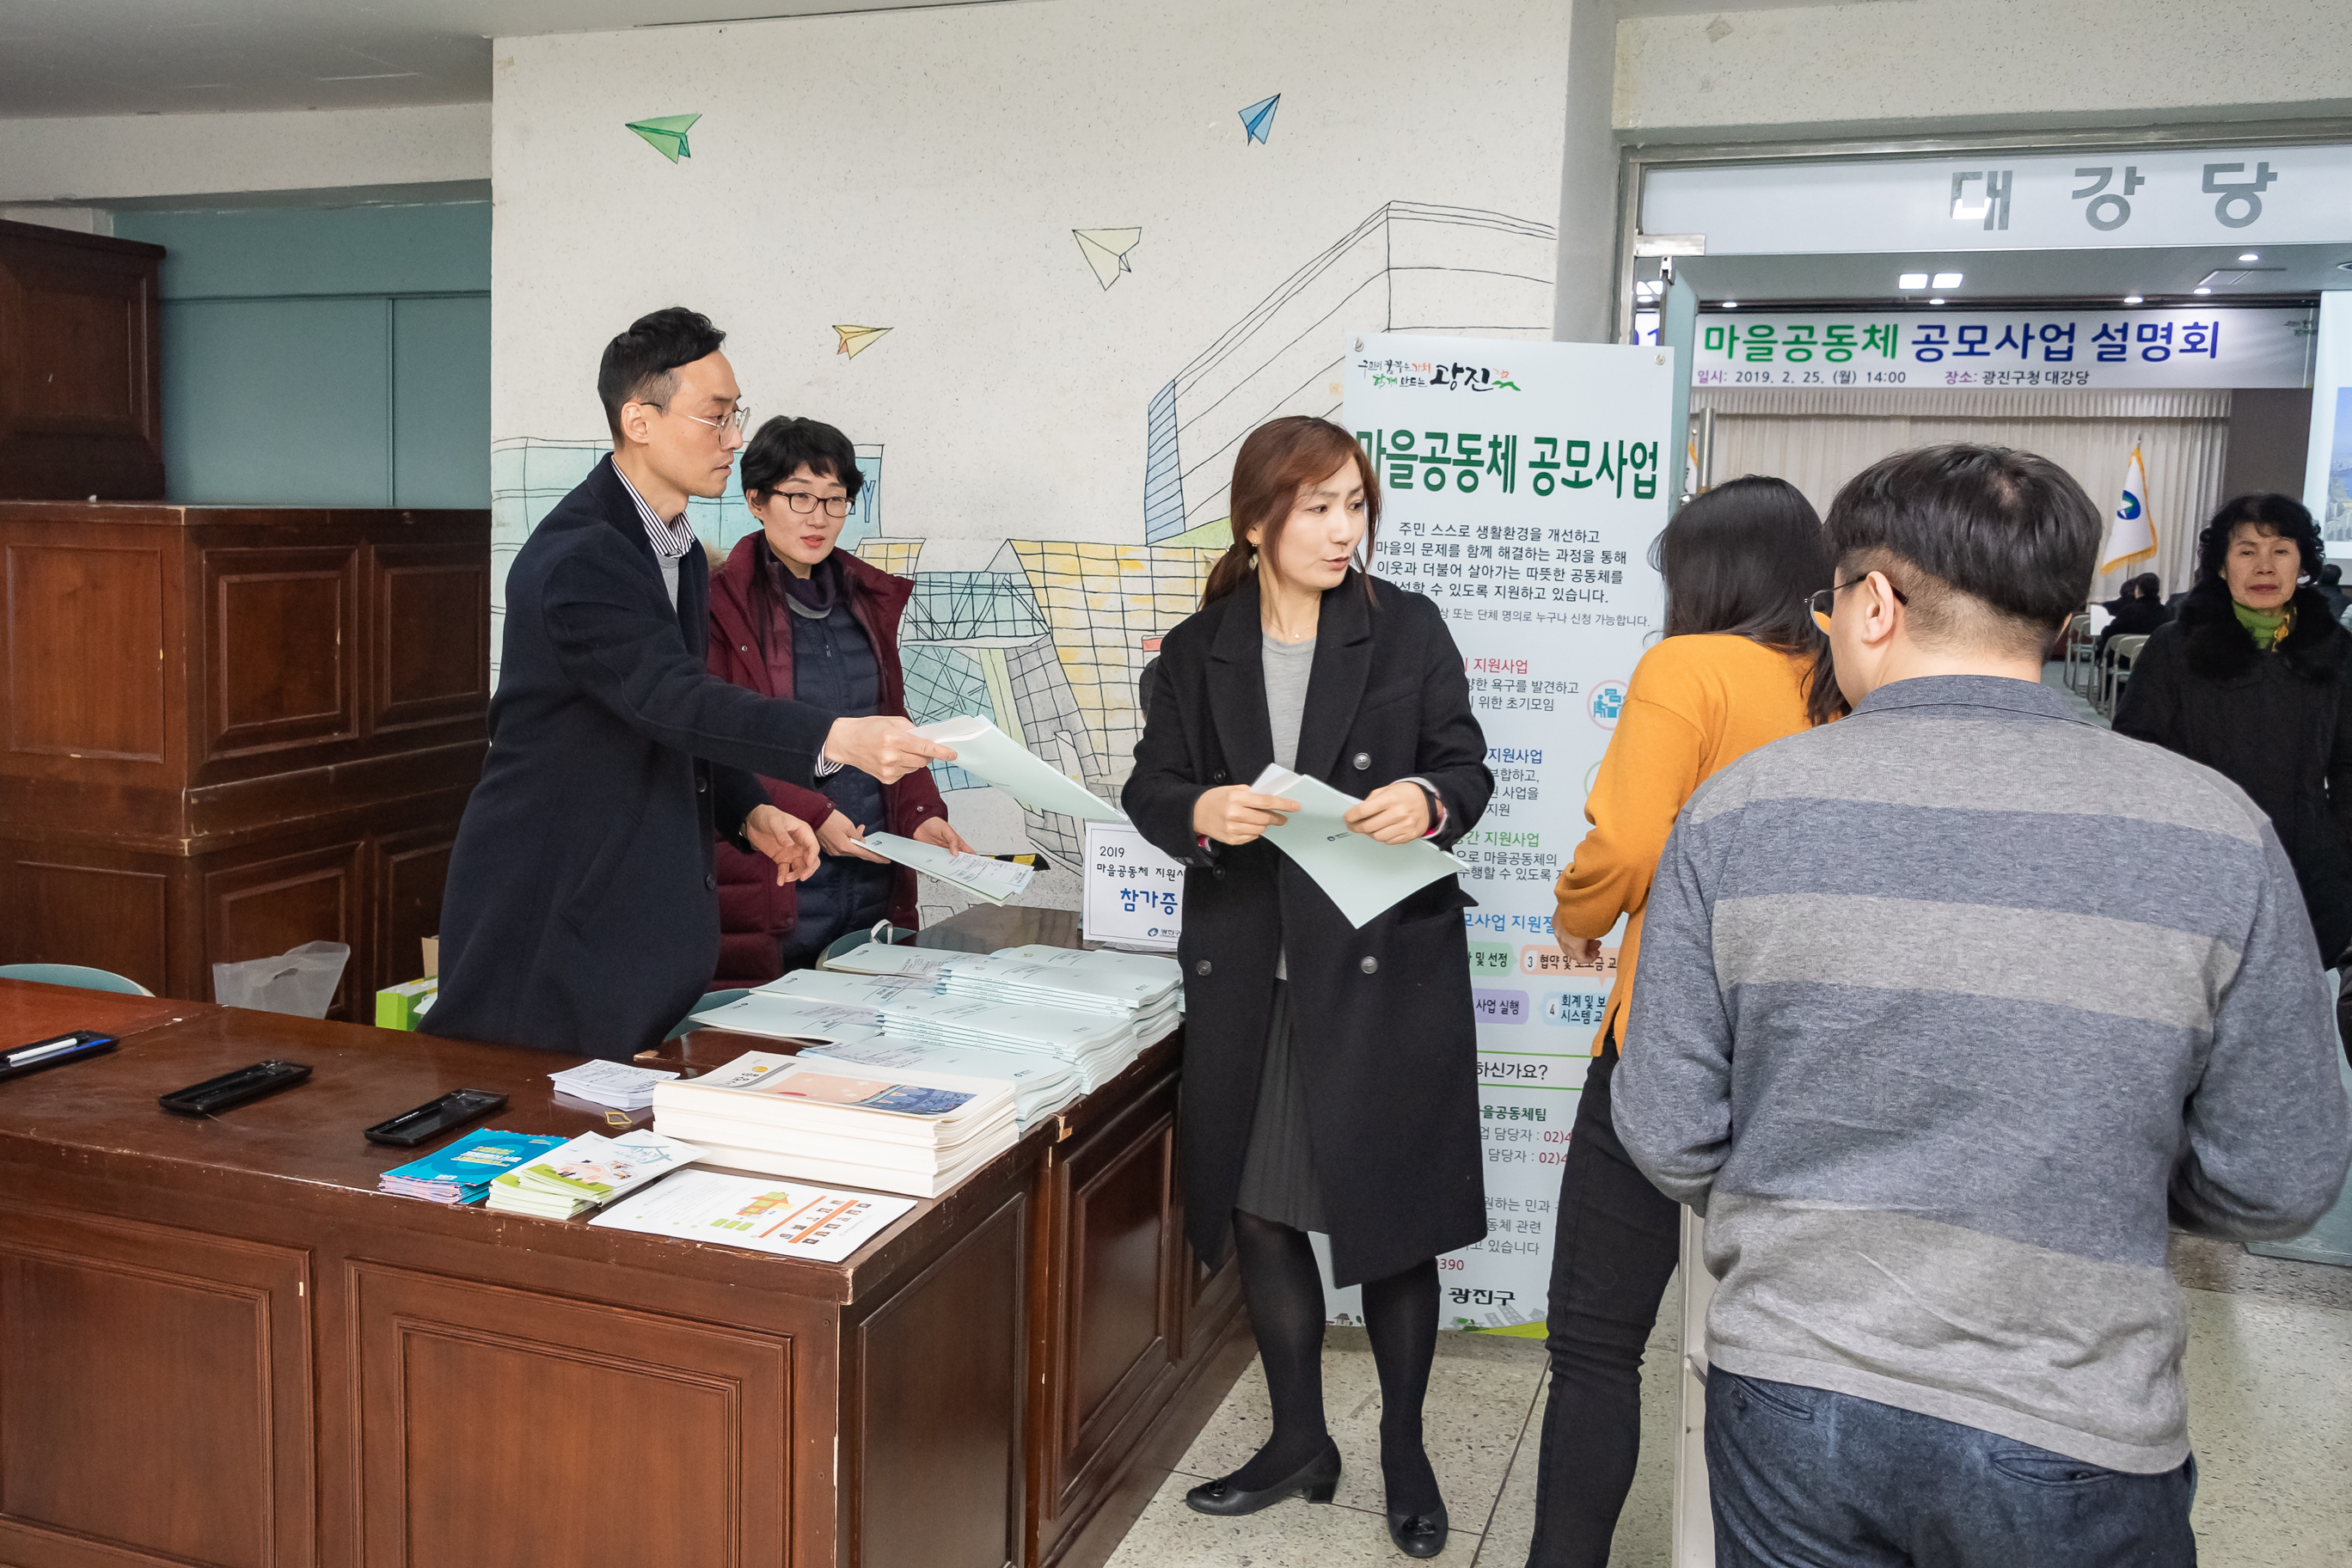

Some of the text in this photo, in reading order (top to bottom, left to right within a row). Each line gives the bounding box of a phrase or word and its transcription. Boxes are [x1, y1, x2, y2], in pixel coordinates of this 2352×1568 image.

[1704, 323, 1899, 363] 마을공동체
[1911, 322, 2076, 363] 공모사업
[2091, 321, 2220, 363] 설명회
[1429, 361, 1494, 392] 광진
[1697, 370, 1907, 386] 일시: 2019. 2. 25. (월) 14:00
[1944, 370, 2091, 385] 장소: 광진구청 대강당
[1528, 436, 1659, 500] 공모사업
[1399, 521, 1601, 543] 주민 스스로 생활환경을 개선하고
[1375, 541, 1627, 565] 마을의 문제를 함께 해결하는 과정을 통해
[1377, 560, 1624, 585] 이웃과 더불어 살아가는 따뜻한 공동체를
[1430, 582, 1443, 597] 수
[1449, 583, 1488, 598] 있도록
[1493, 585, 1547, 601] 지원하고
[1552, 586, 1609, 603] 있습니다.
[1452, 608, 1474, 622] 또는
[1477, 609, 1498, 622] 단체
[1502, 609, 1533, 622] 명의로
[1535, 611, 1567, 624] 누구나
[1570, 613, 1592, 626] 신청
[1595, 613, 1651, 628] 가능합니다.
[1473, 658, 1528, 675] 지원사업
[1491, 678, 1528, 693] 욕구를
[1531, 680, 1580, 695] 발견하고
[1478, 695, 1504, 710] 위한
[1505, 696, 1554, 712] 초기모임
[1487, 747, 1543, 764] 지원사업
[1502, 786, 1540, 800] 사업을
[1485, 803, 1510, 818] 지원
[1484, 831, 1540, 848] 지원사업
[1099, 846, 1125, 858] 2019
[1484, 851, 1558, 867] 마을공동체의
[1096, 863, 1148, 879] 마을공동체
[1498, 867, 1511, 880] 수
[1515, 867, 1553, 882] 있도록
[1120, 887, 1179, 916] 참가증
[1475, 952, 1485, 967] 및
[1487, 952, 1508, 968] 선정
[1527, 956, 1534, 968] 3
[1540, 954, 1560, 970] 협약
[1475, 998, 1520, 1015] 사업 실행
[1561, 994, 1582, 1008] 회계
[1584, 995, 1594, 1010] 및
[1560, 1009, 1590, 1025] 시스템
[1477, 1061, 1548, 1081] 하신가요?
[1479, 1105, 1547, 1122] 을공동체팀
[1494, 1127, 1533, 1142] 담당자
[1488, 1148, 1527, 1164] 담당자
[1525, 1198, 1551, 1214] 민과
[1516, 1220, 1541, 1234] 관련
[1488, 1240, 1540, 1256] 있습니다
[1436, 1258, 1465, 1271] 390
[1448, 1287, 1516, 1307] 광진구
